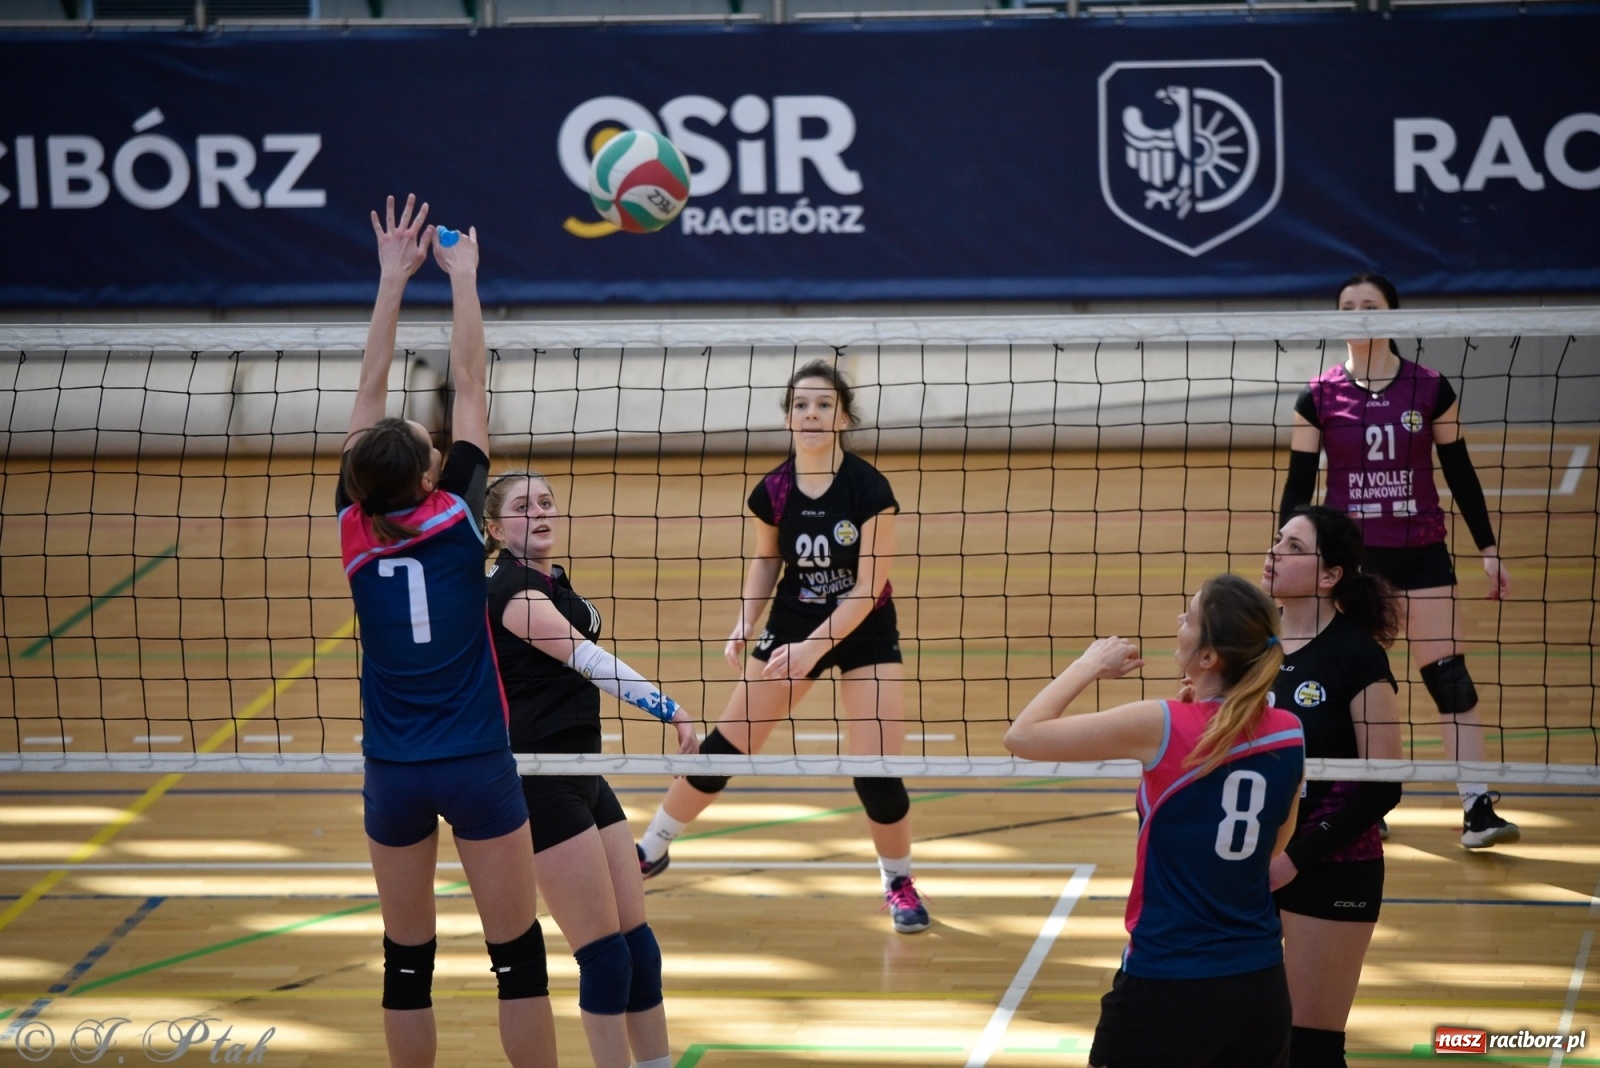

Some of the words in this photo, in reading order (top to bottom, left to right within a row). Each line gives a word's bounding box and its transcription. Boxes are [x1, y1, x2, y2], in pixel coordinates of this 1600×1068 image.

[0, 106, 327, 210] IBÓRZ
[681, 197, 865, 235] RACIBÓRZ
[1365, 424, 1396, 461] 21
[1348, 484, 1413, 500] KRAPKOWICE
[1367, 468, 1414, 487] VOLLEY
[795, 533, 831, 568] 20
[378, 557, 432, 644] 7
[1215, 769, 1268, 861] 8
[1333, 900, 1367, 908] COLO
